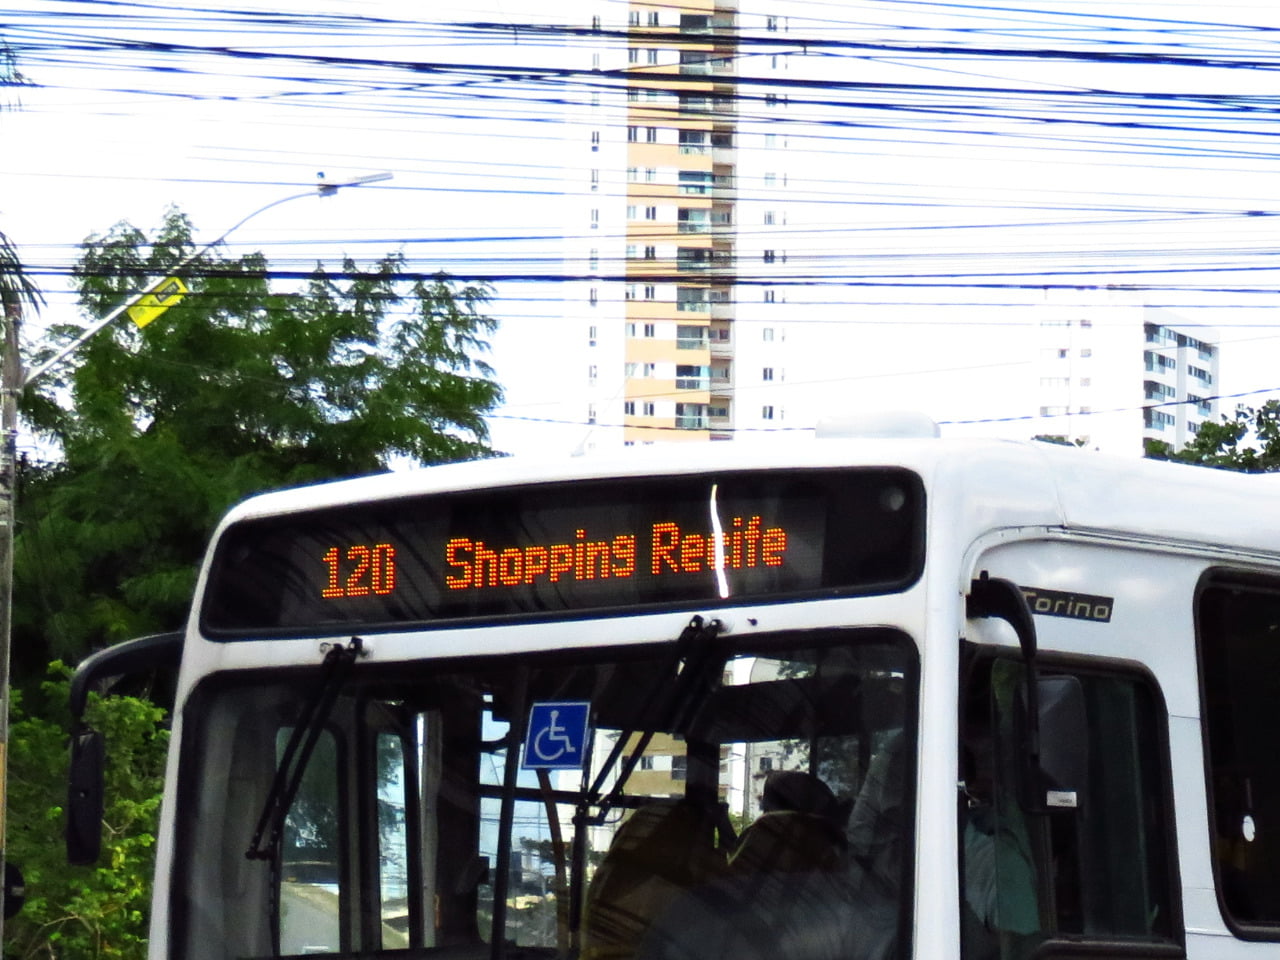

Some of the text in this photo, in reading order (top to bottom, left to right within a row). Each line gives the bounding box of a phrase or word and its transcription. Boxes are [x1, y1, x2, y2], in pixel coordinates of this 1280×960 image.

[322, 514, 787, 599] 120 Shopping Recife
